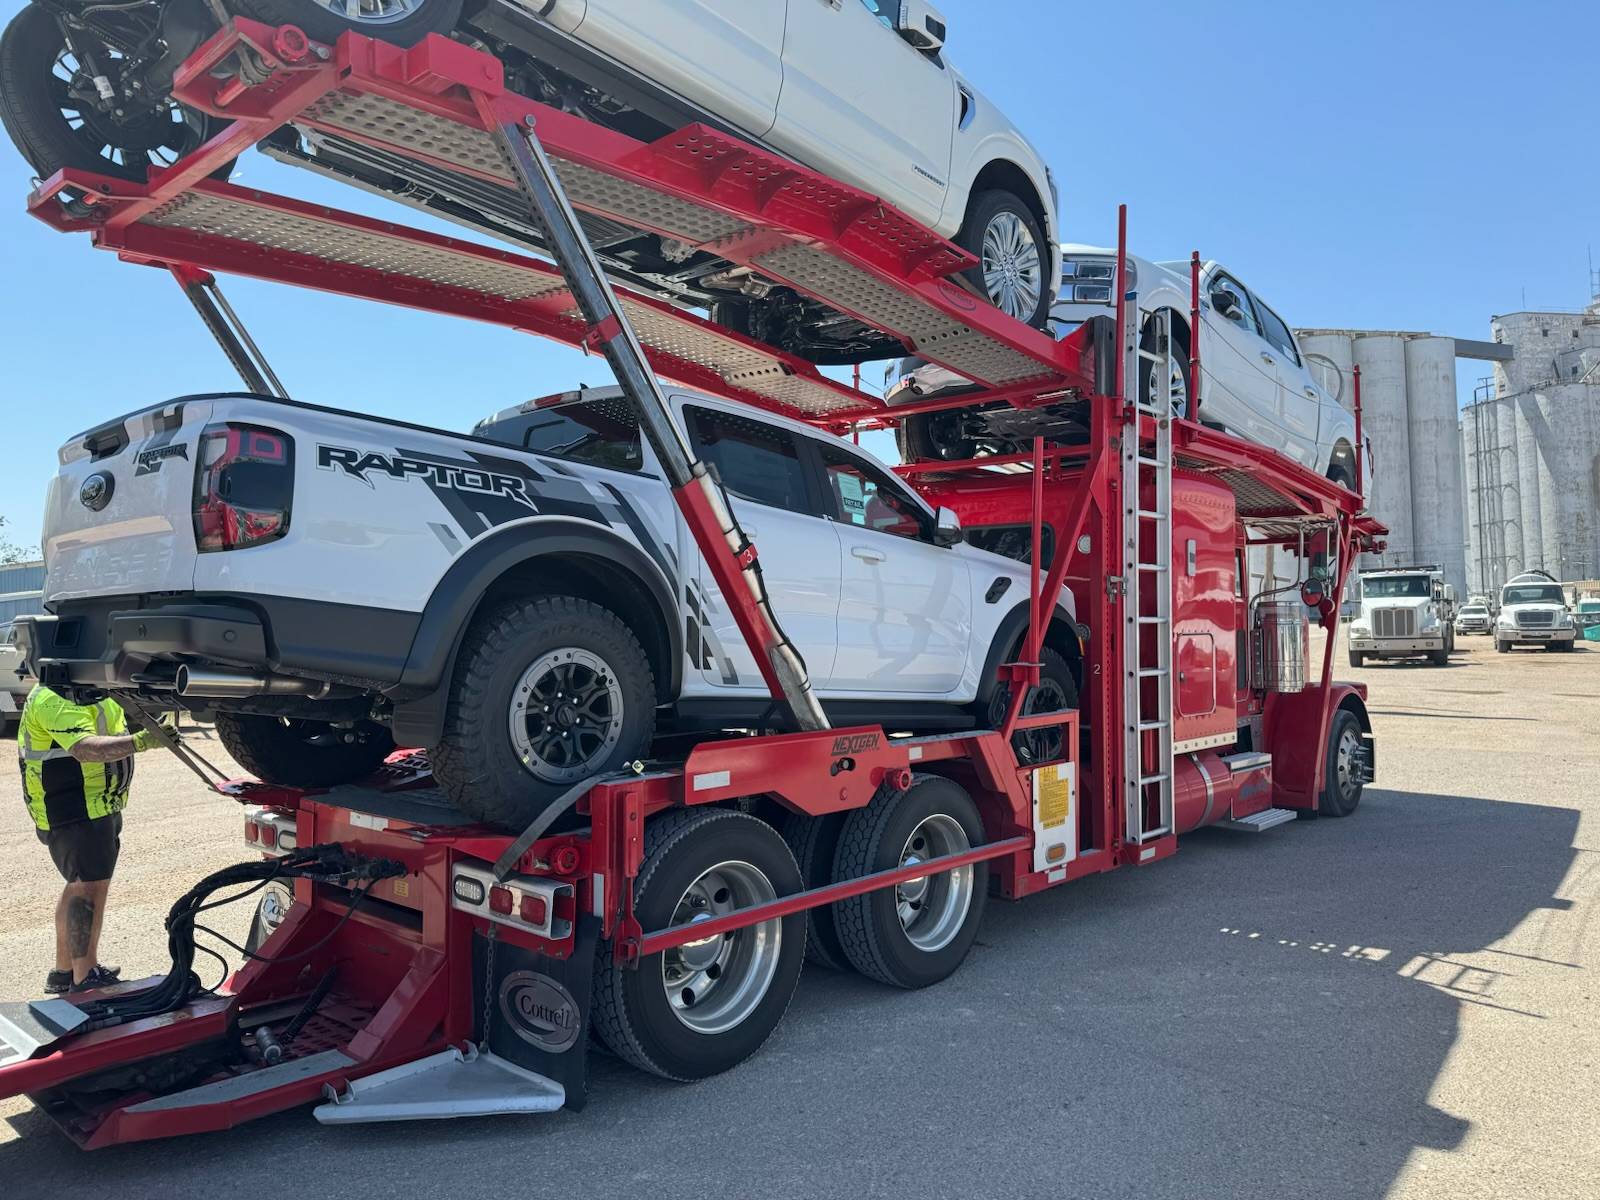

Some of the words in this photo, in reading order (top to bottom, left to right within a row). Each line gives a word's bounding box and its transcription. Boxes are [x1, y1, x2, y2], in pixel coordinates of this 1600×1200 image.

[138, 442, 189, 470] RAPTOR
[316, 442, 540, 514] RAPTOR
[743, 549, 753, 563] 3
[1093, 663, 1101, 675] 2
[831, 733, 880, 756] NEXTGEN
[520, 995, 570, 1030] Cottrell
